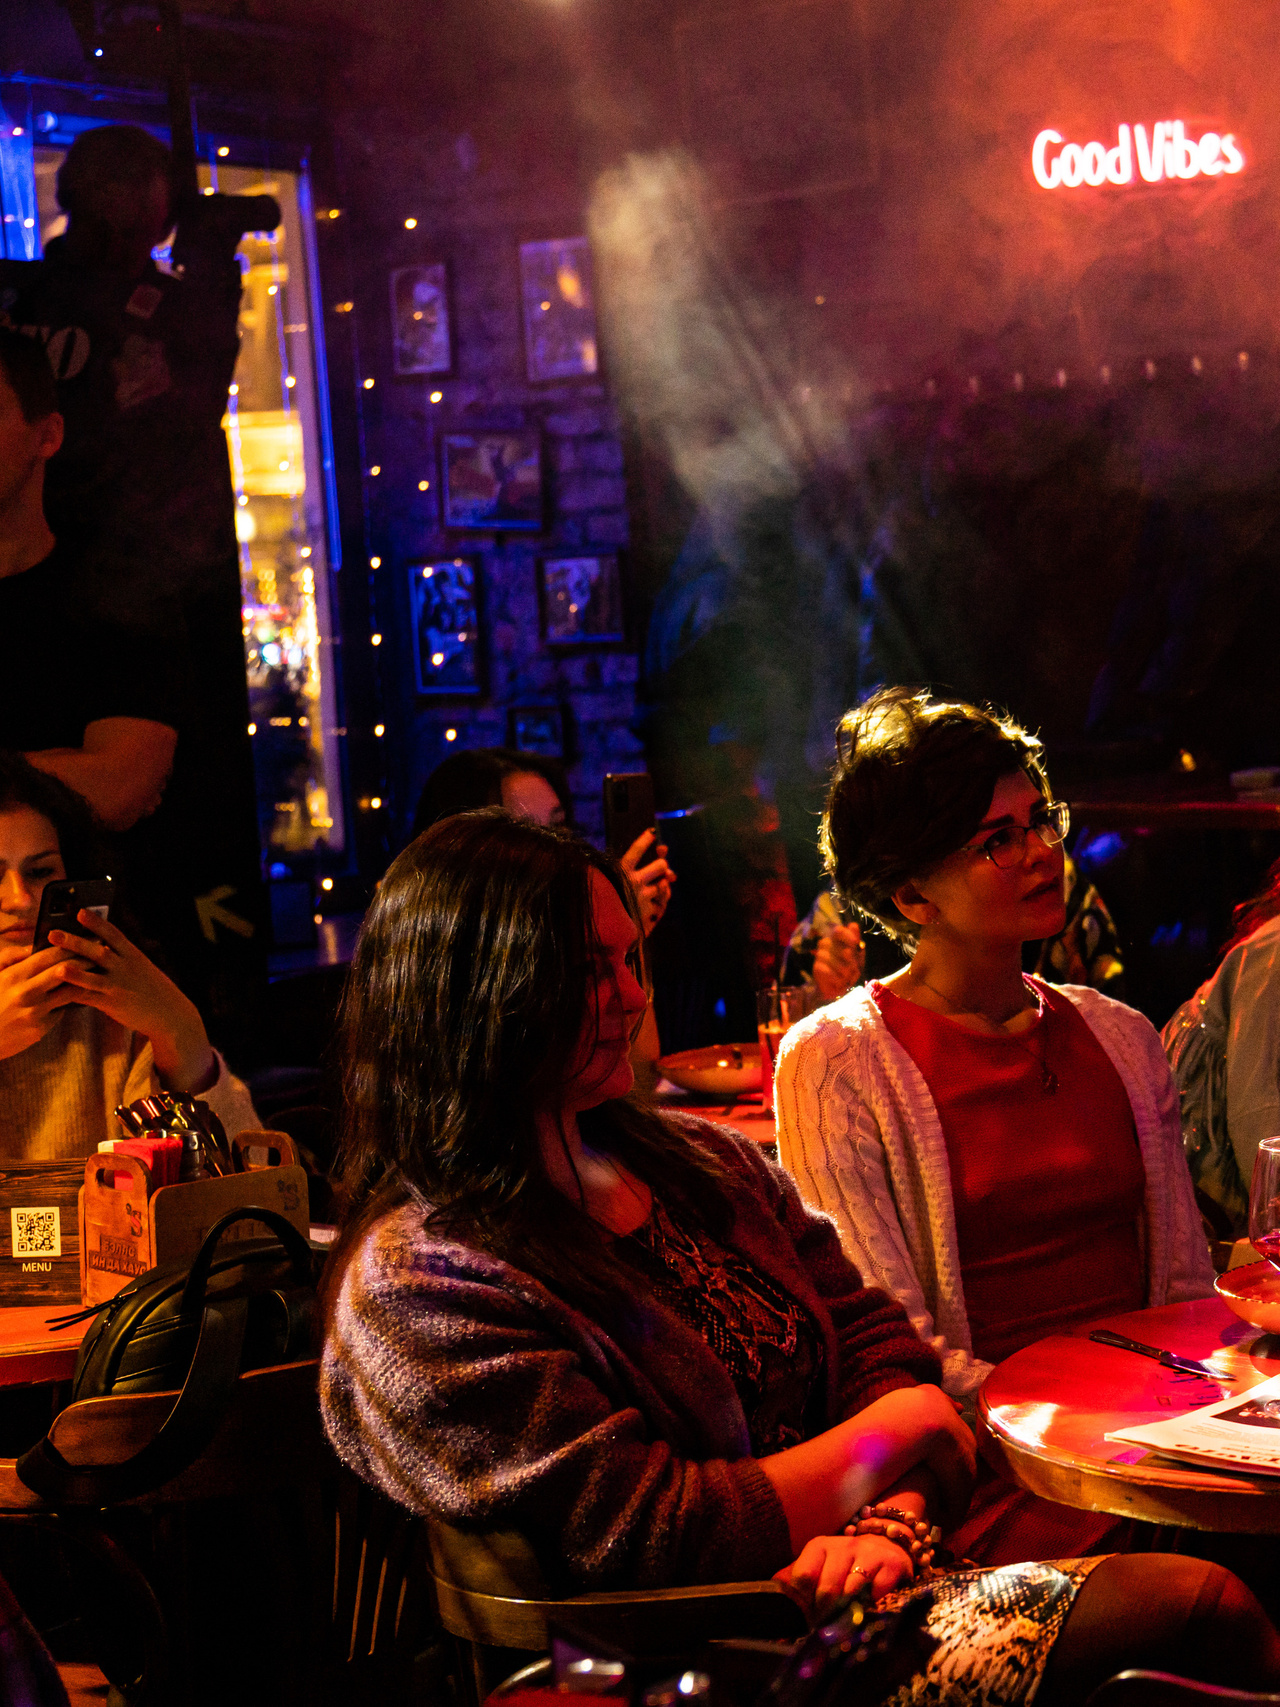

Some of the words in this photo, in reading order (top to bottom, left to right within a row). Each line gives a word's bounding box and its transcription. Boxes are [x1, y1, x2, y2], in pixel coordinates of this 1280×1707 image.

[1031, 123, 1131, 189] Good
[1134, 119, 1243, 182] Vibes
[22, 1262, 52, 1272] MENU
[92, 1254, 106, 1268] ИН
[106, 1257, 120, 1272] ДА
